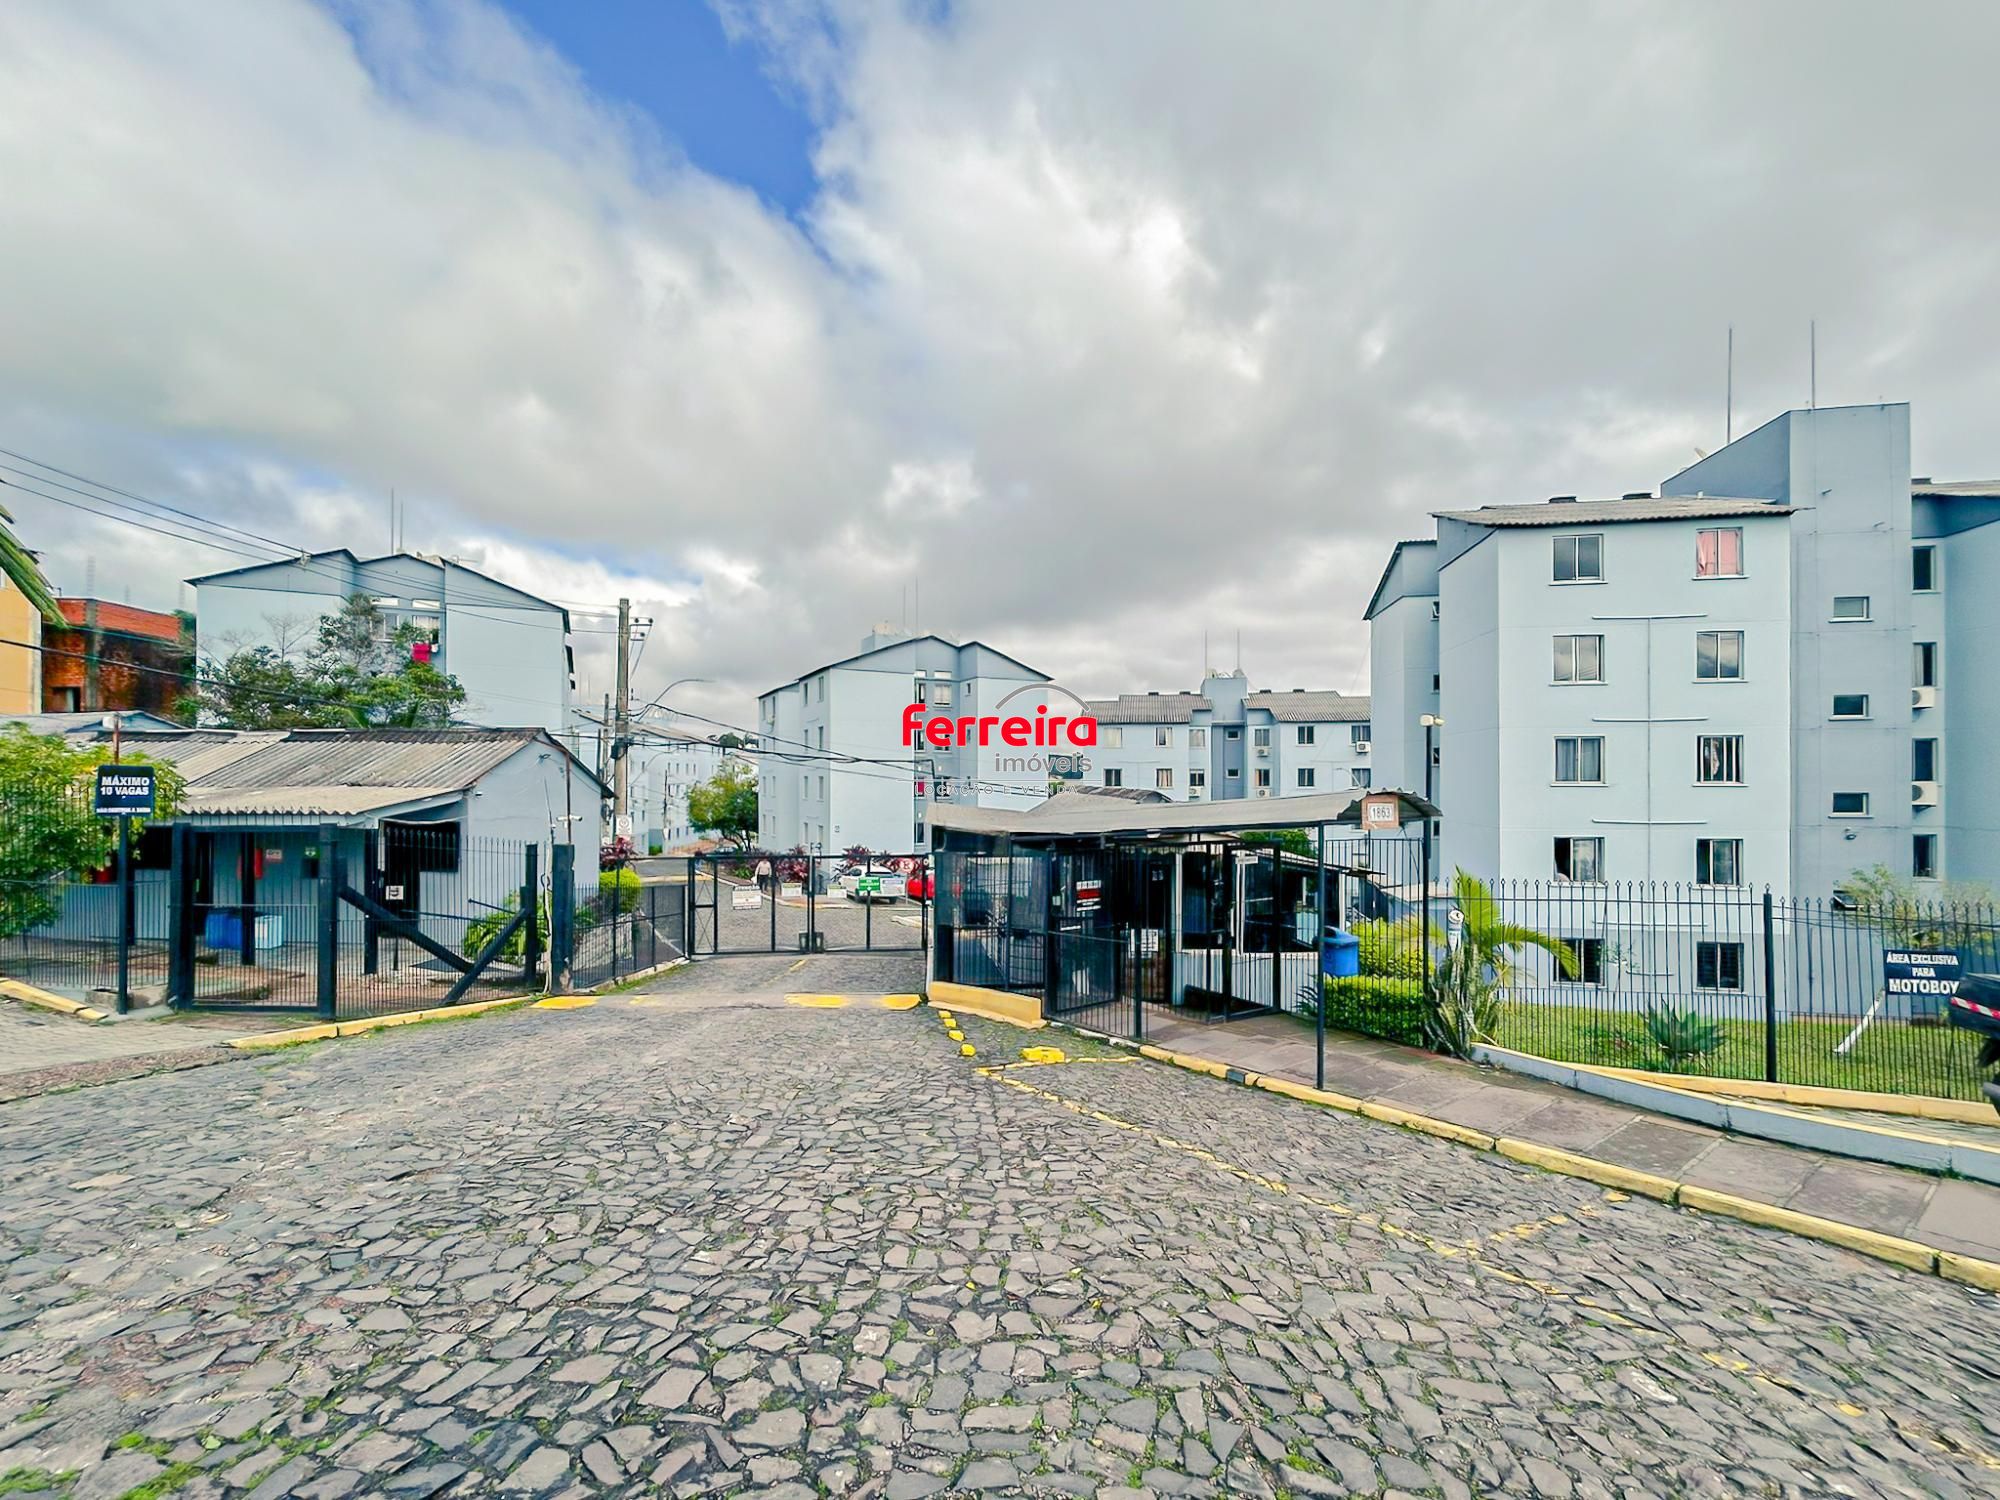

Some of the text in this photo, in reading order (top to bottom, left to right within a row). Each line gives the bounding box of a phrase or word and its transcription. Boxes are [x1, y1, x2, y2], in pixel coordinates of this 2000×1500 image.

[101, 774, 150, 786] MÁXIMO
[100, 786, 149, 796] 10 VAGAS
[1372, 807, 1391, 819] 1863
[1886, 951, 1959, 966] ÁREA EXCLUSIVA
[1911, 966, 1936, 977] PARA
[1888, 978, 1960, 995] MOTOBOY
